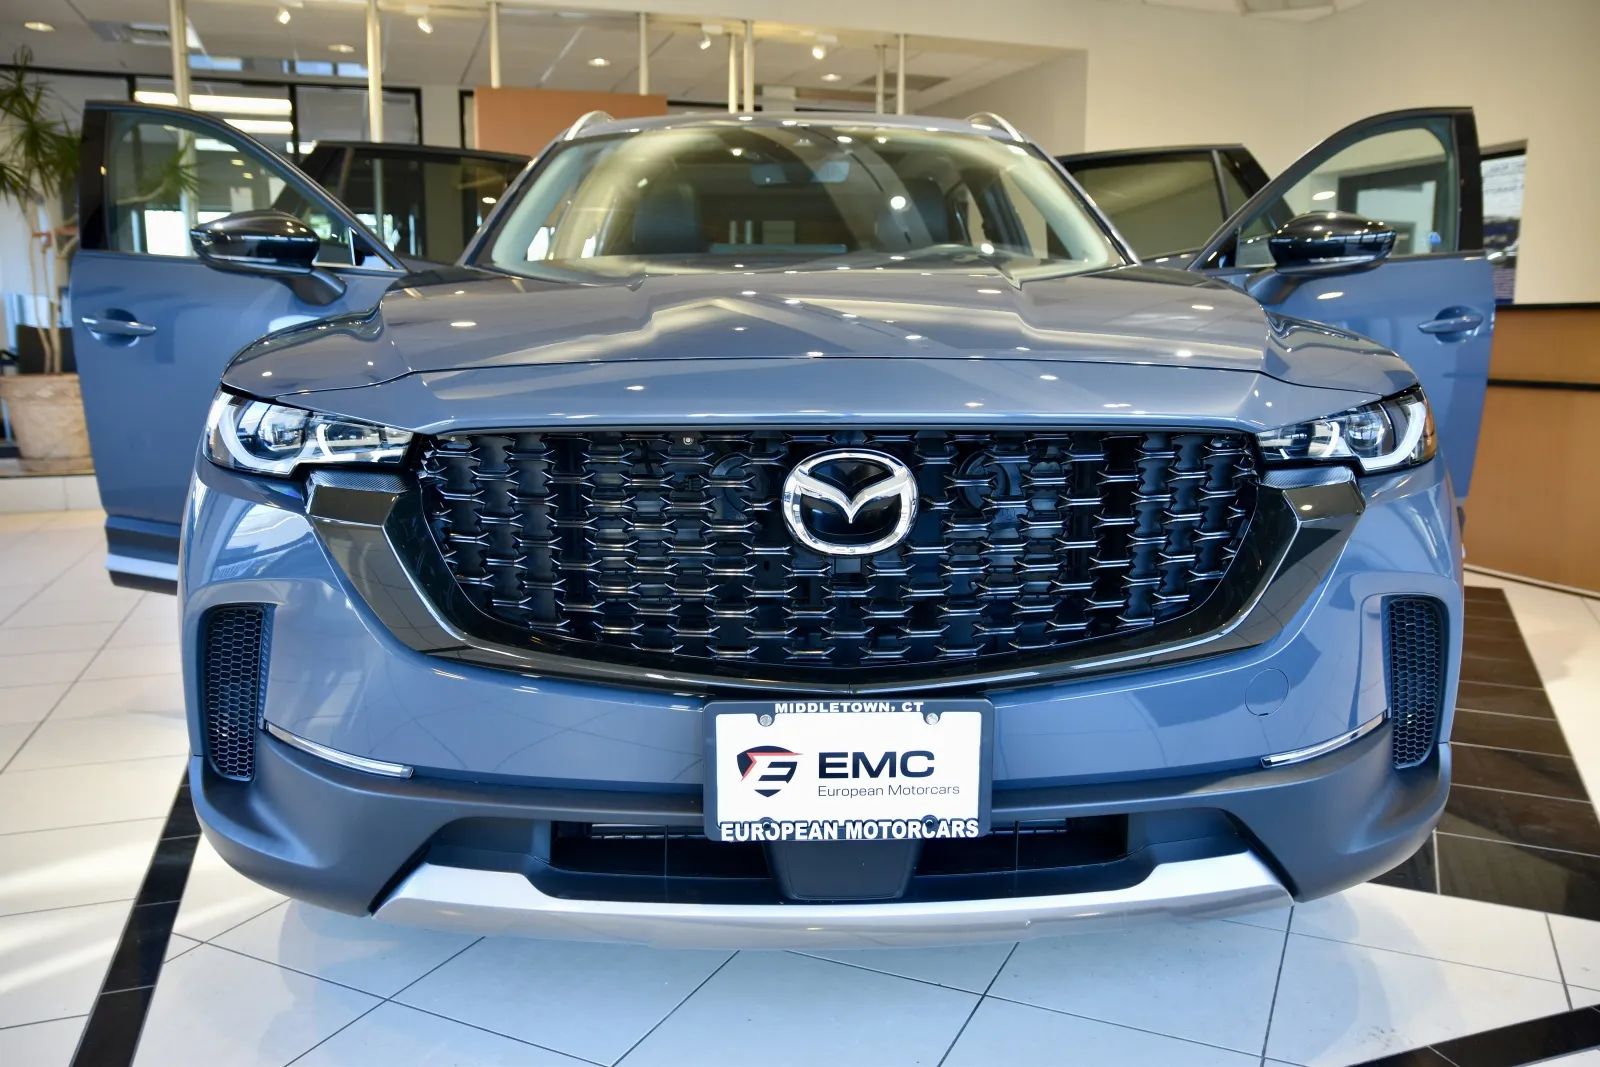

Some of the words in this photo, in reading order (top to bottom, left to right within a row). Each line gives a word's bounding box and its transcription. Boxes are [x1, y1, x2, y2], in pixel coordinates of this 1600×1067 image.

[774, 702, 896, 713] MIDDLETOWN,
[901, 701, 924, 712] CT
[818, 750, 935, 779] EMC
[818, 785, 884, 798] European
[889, 784, 960, 797] Motorcars
[720, 821, 838, 841] EUROPEAN
[845, 820, 979, 840] MOTORCARS
